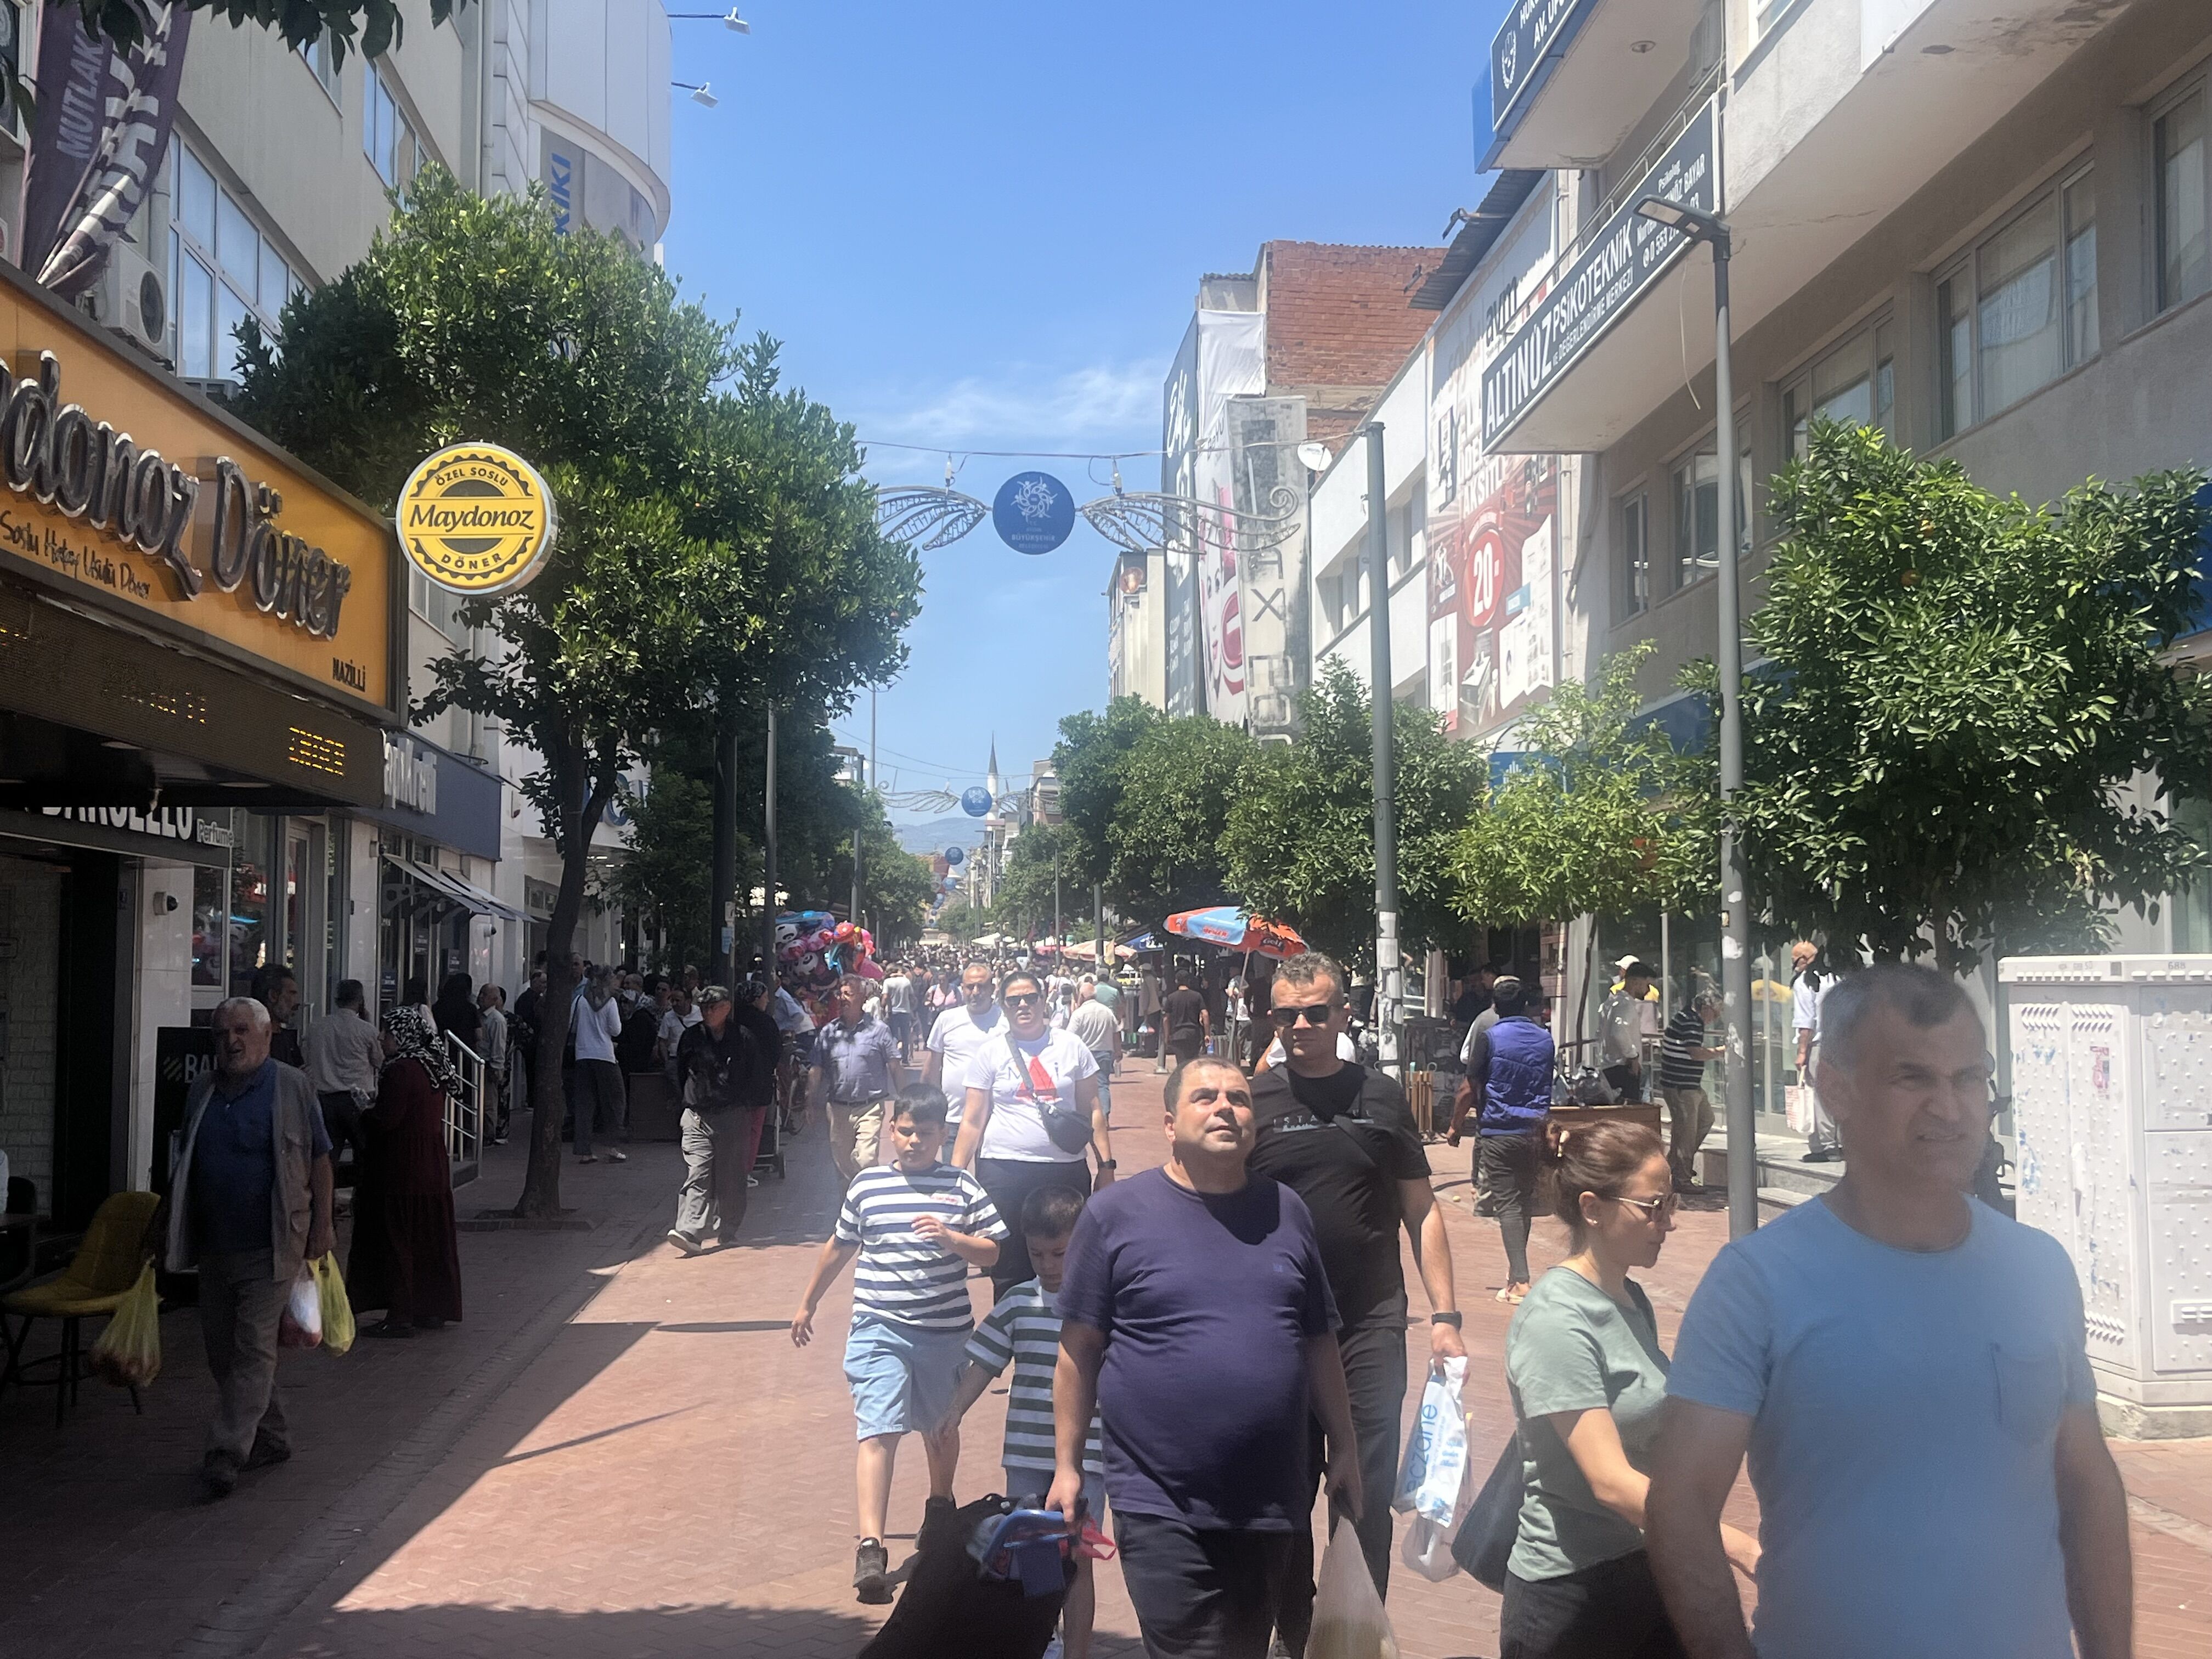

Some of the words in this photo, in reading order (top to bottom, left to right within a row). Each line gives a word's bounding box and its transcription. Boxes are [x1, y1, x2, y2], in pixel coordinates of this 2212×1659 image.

[1684, 153, 1705, 194] BAYAR
[1485, 311, 1553, 439] ALTINÖZ
[1553, 217, 1633, 342] PSİKOTEKNİK
[0, 349, 204, 601] donoz
[435, 468, 466, 486] ÖZEL
[470, 467, 509, 487] SOSLU
[409, 504, 535, 533] Maydonoz
[441, 552, 503, 569] DÖNER
[196, 817, 234, 848] Perfume
